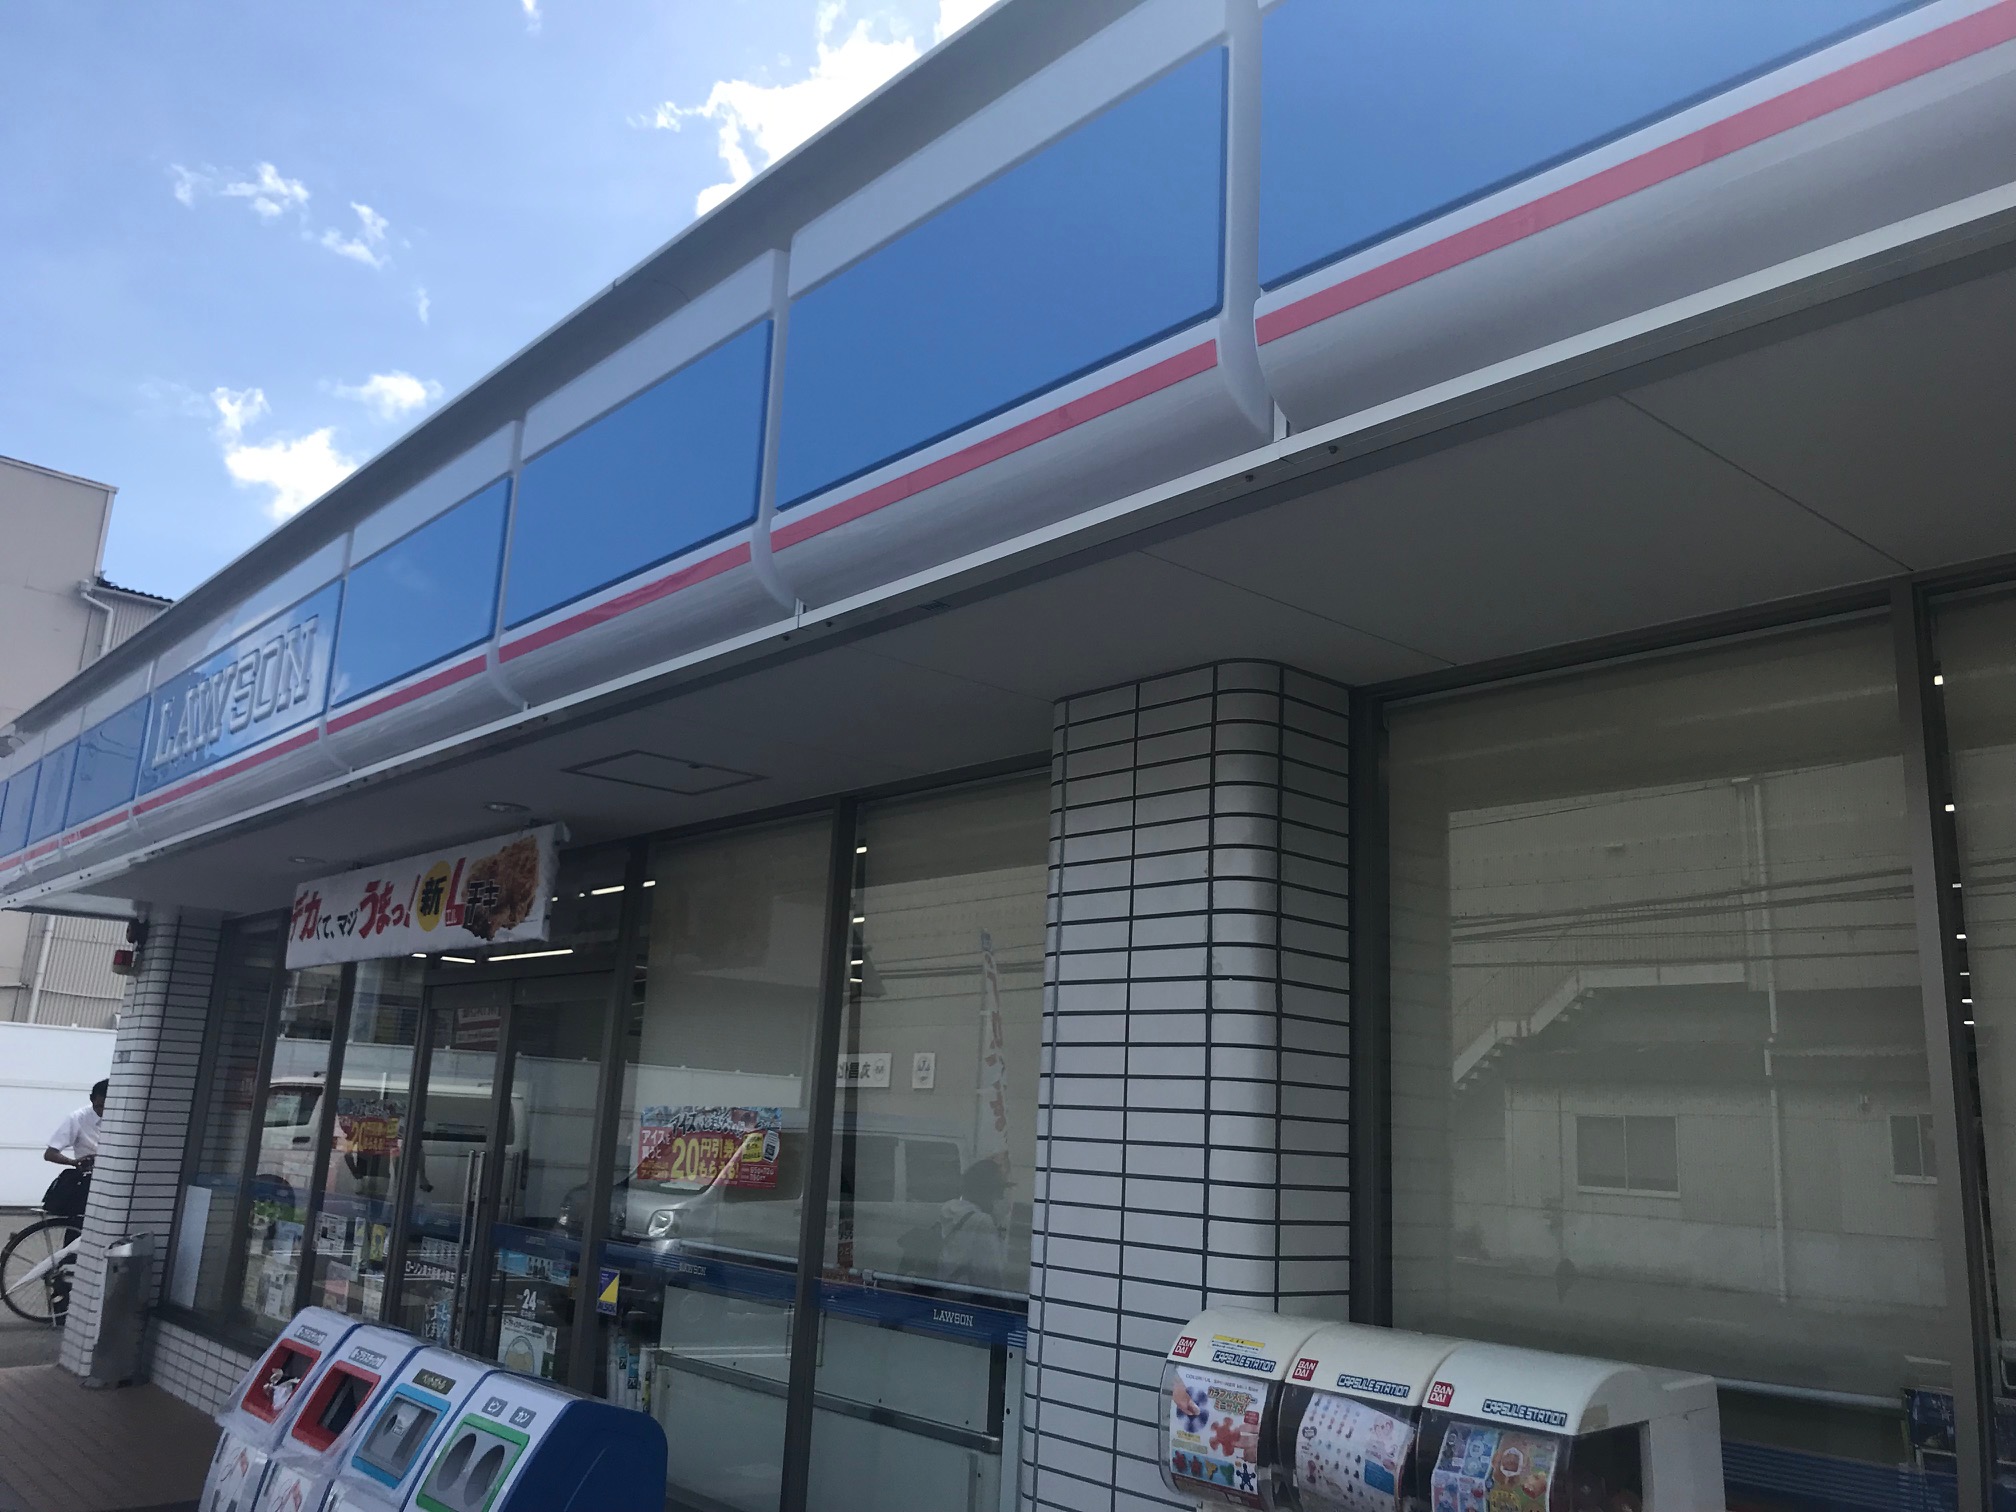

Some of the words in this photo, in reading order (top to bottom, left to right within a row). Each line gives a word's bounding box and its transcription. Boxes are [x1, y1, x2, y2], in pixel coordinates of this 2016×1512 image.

[152, 614, 318, 769] LAWSON
[522, 1288, 538, 1311] 24
[932, 1308, 974, 1327] LAWSON
[1174, 1345, 1189, 1355] DAI
[1178, 1337, 1195, 1348] BAN
[1213, 1351, 1246, 1365] CAPSULE
[1244, 1357, 1276, 1372] STATION
[1298, 1360, 1316, 1370] BAN
[1294, 1368, 1310, 1378] DAI
[1338, 1375, 1376, 1390] CAPSULE
[1374, 1381, 1410, 1397] STATION
[1433, 1383, 1453, 1395] BAN
[1429, 1392, 1447, 1403] DAI
[1483, 1399, 1526, 1418] CAPSULE
[1524, 1407, 1567, 1426] STATION
